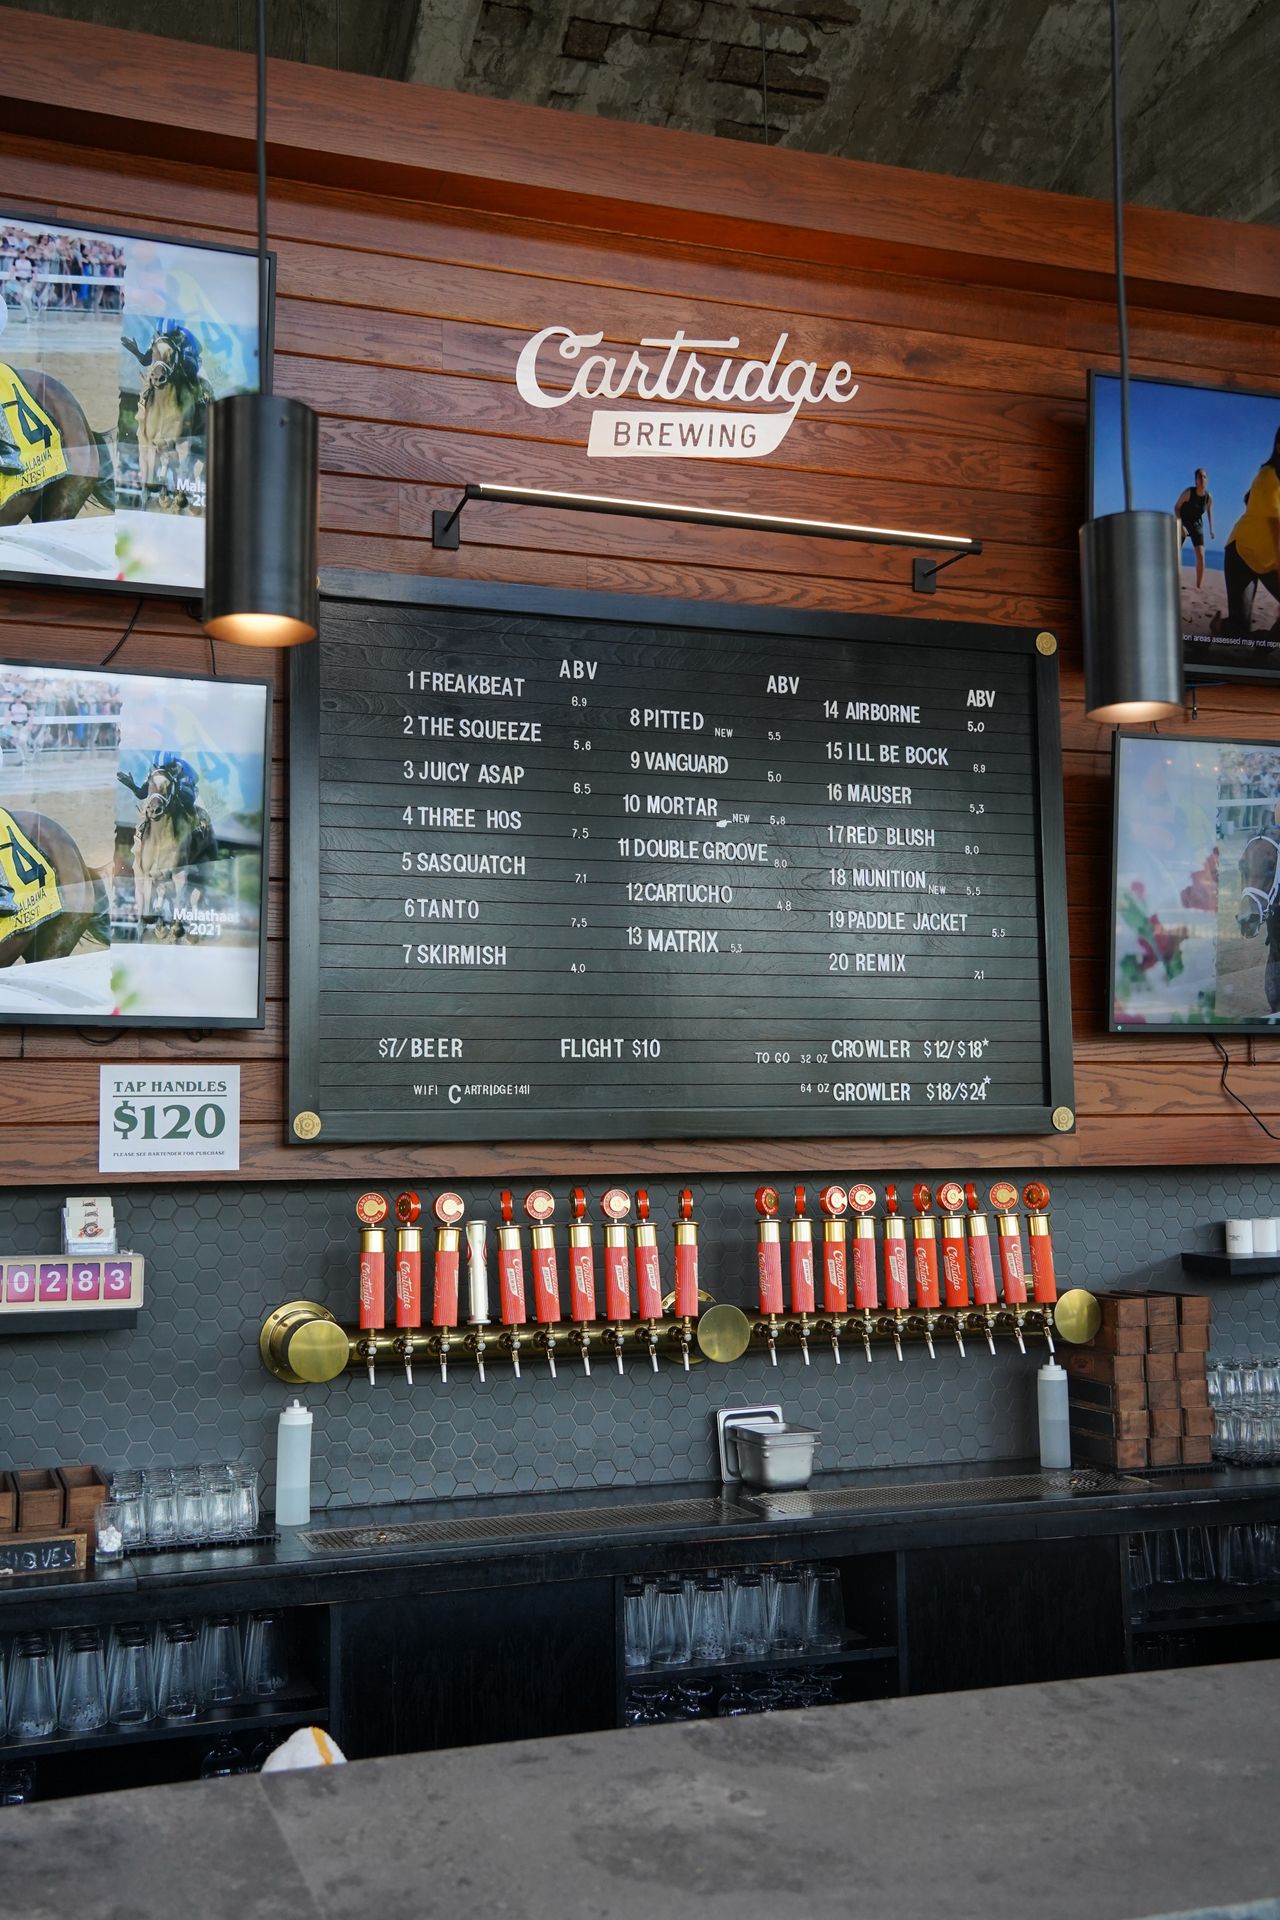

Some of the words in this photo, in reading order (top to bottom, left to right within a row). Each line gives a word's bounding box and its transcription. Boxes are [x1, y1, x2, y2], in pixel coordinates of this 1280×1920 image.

[516, 326, 859, 417] Cartridge
[614, 422, 756, 448] BREWING
[560, 660, 597, 679] ABV
[421, 672, 525, 696] FREAKBEAT
[572, 696, 587, 706] 6.9
[767, 675, 799, 694] ABV
[967, 690, 995, 707] ABV
[645, 709, 704, 730] PITTED
[715, 728, 733, 737] NEW
[824, 700, 838, 718] 14
[846, 702, 920, 723] AIRBORNE
[968, 721, 984, 732] 5.0
[404, 716, 413, 734] 2
[418, 716, 454, 736] THE
[459, 719, 541, 742] SQUEEZE
[574, 740, 591, 750] 5.6
[768, 732, 781, 740] 5.5
[631, 751, 640, 768] 9
[644, 752, 728, 774] VANGUARD
[826, 742, 842, 759] 15
[849, 743, 874, 761] ILL
[880, 745, 899, 763] BE
[906, 746, 948, 765] BOCK
[404, 761, 414, 778] 3
[419, 761, 469, 782] JUICY
[478, 765, 524, 784] ASAP
[574, 783, 591, 794] 6.5
[768, 771, 781, 782] 5.0
[623, 794, 640, 812] 10
[647, 795, 717, 816] MORTAR
[733, 814, 750, 823] NEW
[770, 816, 785, 825] 5.8
[827, 784, 842, 801] 16
[848, 784, 911, 804] MAUSER
[970, 804, 984, 814] 5.3
[403, 806, 413, 824] 4
[418, 807, 475, 827] THREE
[487, 810, 521, 829] HOS
[572, 828, 588, 839] 7.5
[828, 826, 844, 843] 17
[847, 826, 877, 844] RED
[887, 828, 934, 846] BLUSH
[618, 838, 629, 856] 11
[635, 839, 699, 858] DOUBLE
[703, 842, 768, 861] GROOVE
[402, 852, 411, 870] 5
[417, 853, 525, 874] SASQUATCH
[830, 868, 846, 885] 18
[853, 869, 925, 888] MUNITION
[929, 884, 946, 894] NEW
[967, 887, 980, 895] 5.5
[626, 883, 643, 901] 12
[645, 884, 732, 904] CARTUCHO
[405, 899, 414, 917] 6
[417, 899, 479, 918] TANTO
[190, 924, 221, 935] 2021
[828, 911, 844, 928] 19
[848, 911, 905, 929] PADDLE
[913, 912, 967, 931] JACKET
[992, 929, 1005, 937] 5.5
[626, 927, 642, 945] 13
[648, 930, 718, 952] MATRIX
[403, 945, 412, 963] 7
[417, 944, 506, 965] SKIRMISH
[571, 964, 585, 973] 4.0
[829, 953, 848, 970] 20
[856, 954, 905, 971] REMIX
[561, 1038, 624, 1058] FLIGHT
[633, 1039, 660, 1057] $10
[755, 1052, 769, 1063] TO
[775, 1052, 789, 1063] GO
[801, 1054, 811, 1063] 32
[817, 1054, 827, 1063] OZ
[832, 1040, 910, 1058] CROWLER
[114, 1082, 146, 1092] TAP
[152, 1081, 227, 1092] HANDLES
[414, 1085, 437, 1095] WIFI
[801, 1084, 811, 1092] 64
[818, 1084, 829, 1092] OZ
[834, 1083, 910, 1101] GROWLER
[113, 1101, 225, 1139] $120
